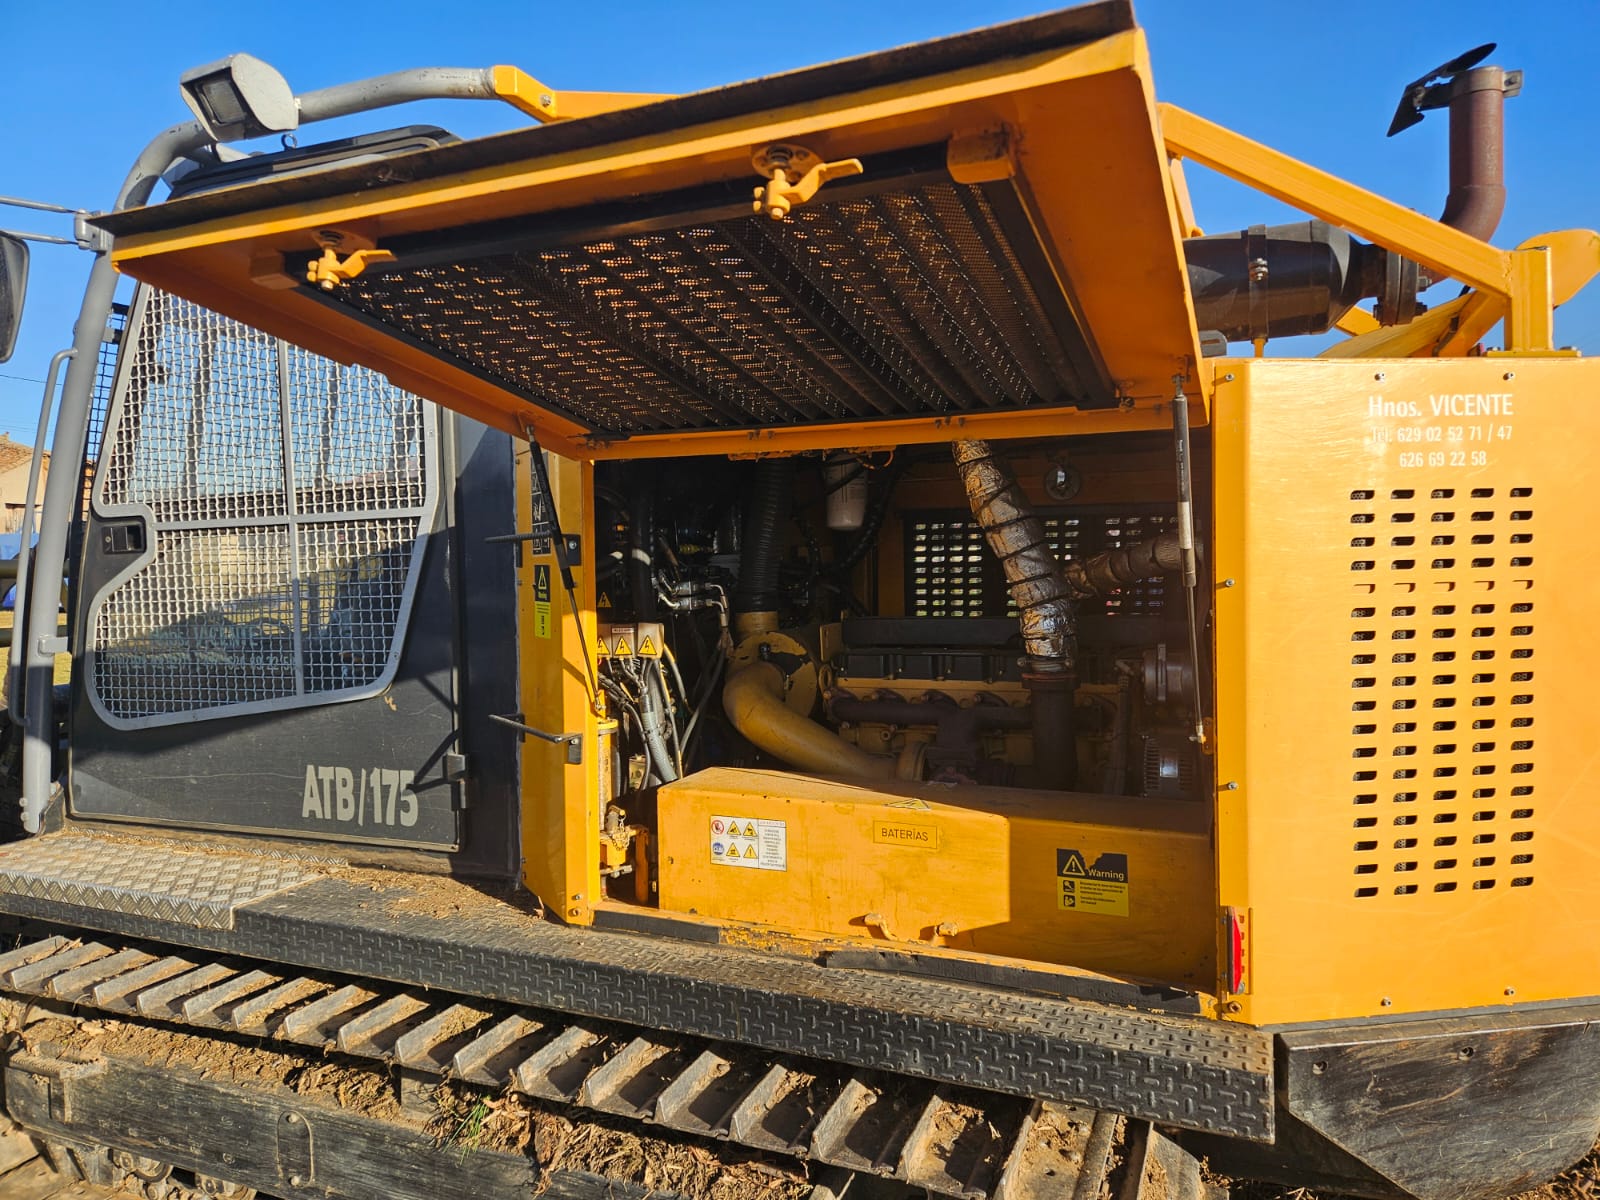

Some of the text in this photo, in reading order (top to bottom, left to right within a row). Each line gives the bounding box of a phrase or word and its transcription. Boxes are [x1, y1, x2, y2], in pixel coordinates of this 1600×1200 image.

[1368, 393, 1514, 417] Hnos. VICENTE
[1397, 426, 1421, 442] 629
[1426, 426, 1442, 442] 02
[1447, 426, 1463, 442] 52
[1468, 425, 1483, 441] 71
[1496, 425, 1513, 440] 47
[1399, 451, 1487, 468] 626 69 22 58
[302, 764, 419, 827] ATB/175
[1087, 868, 1125, 881] Warning
